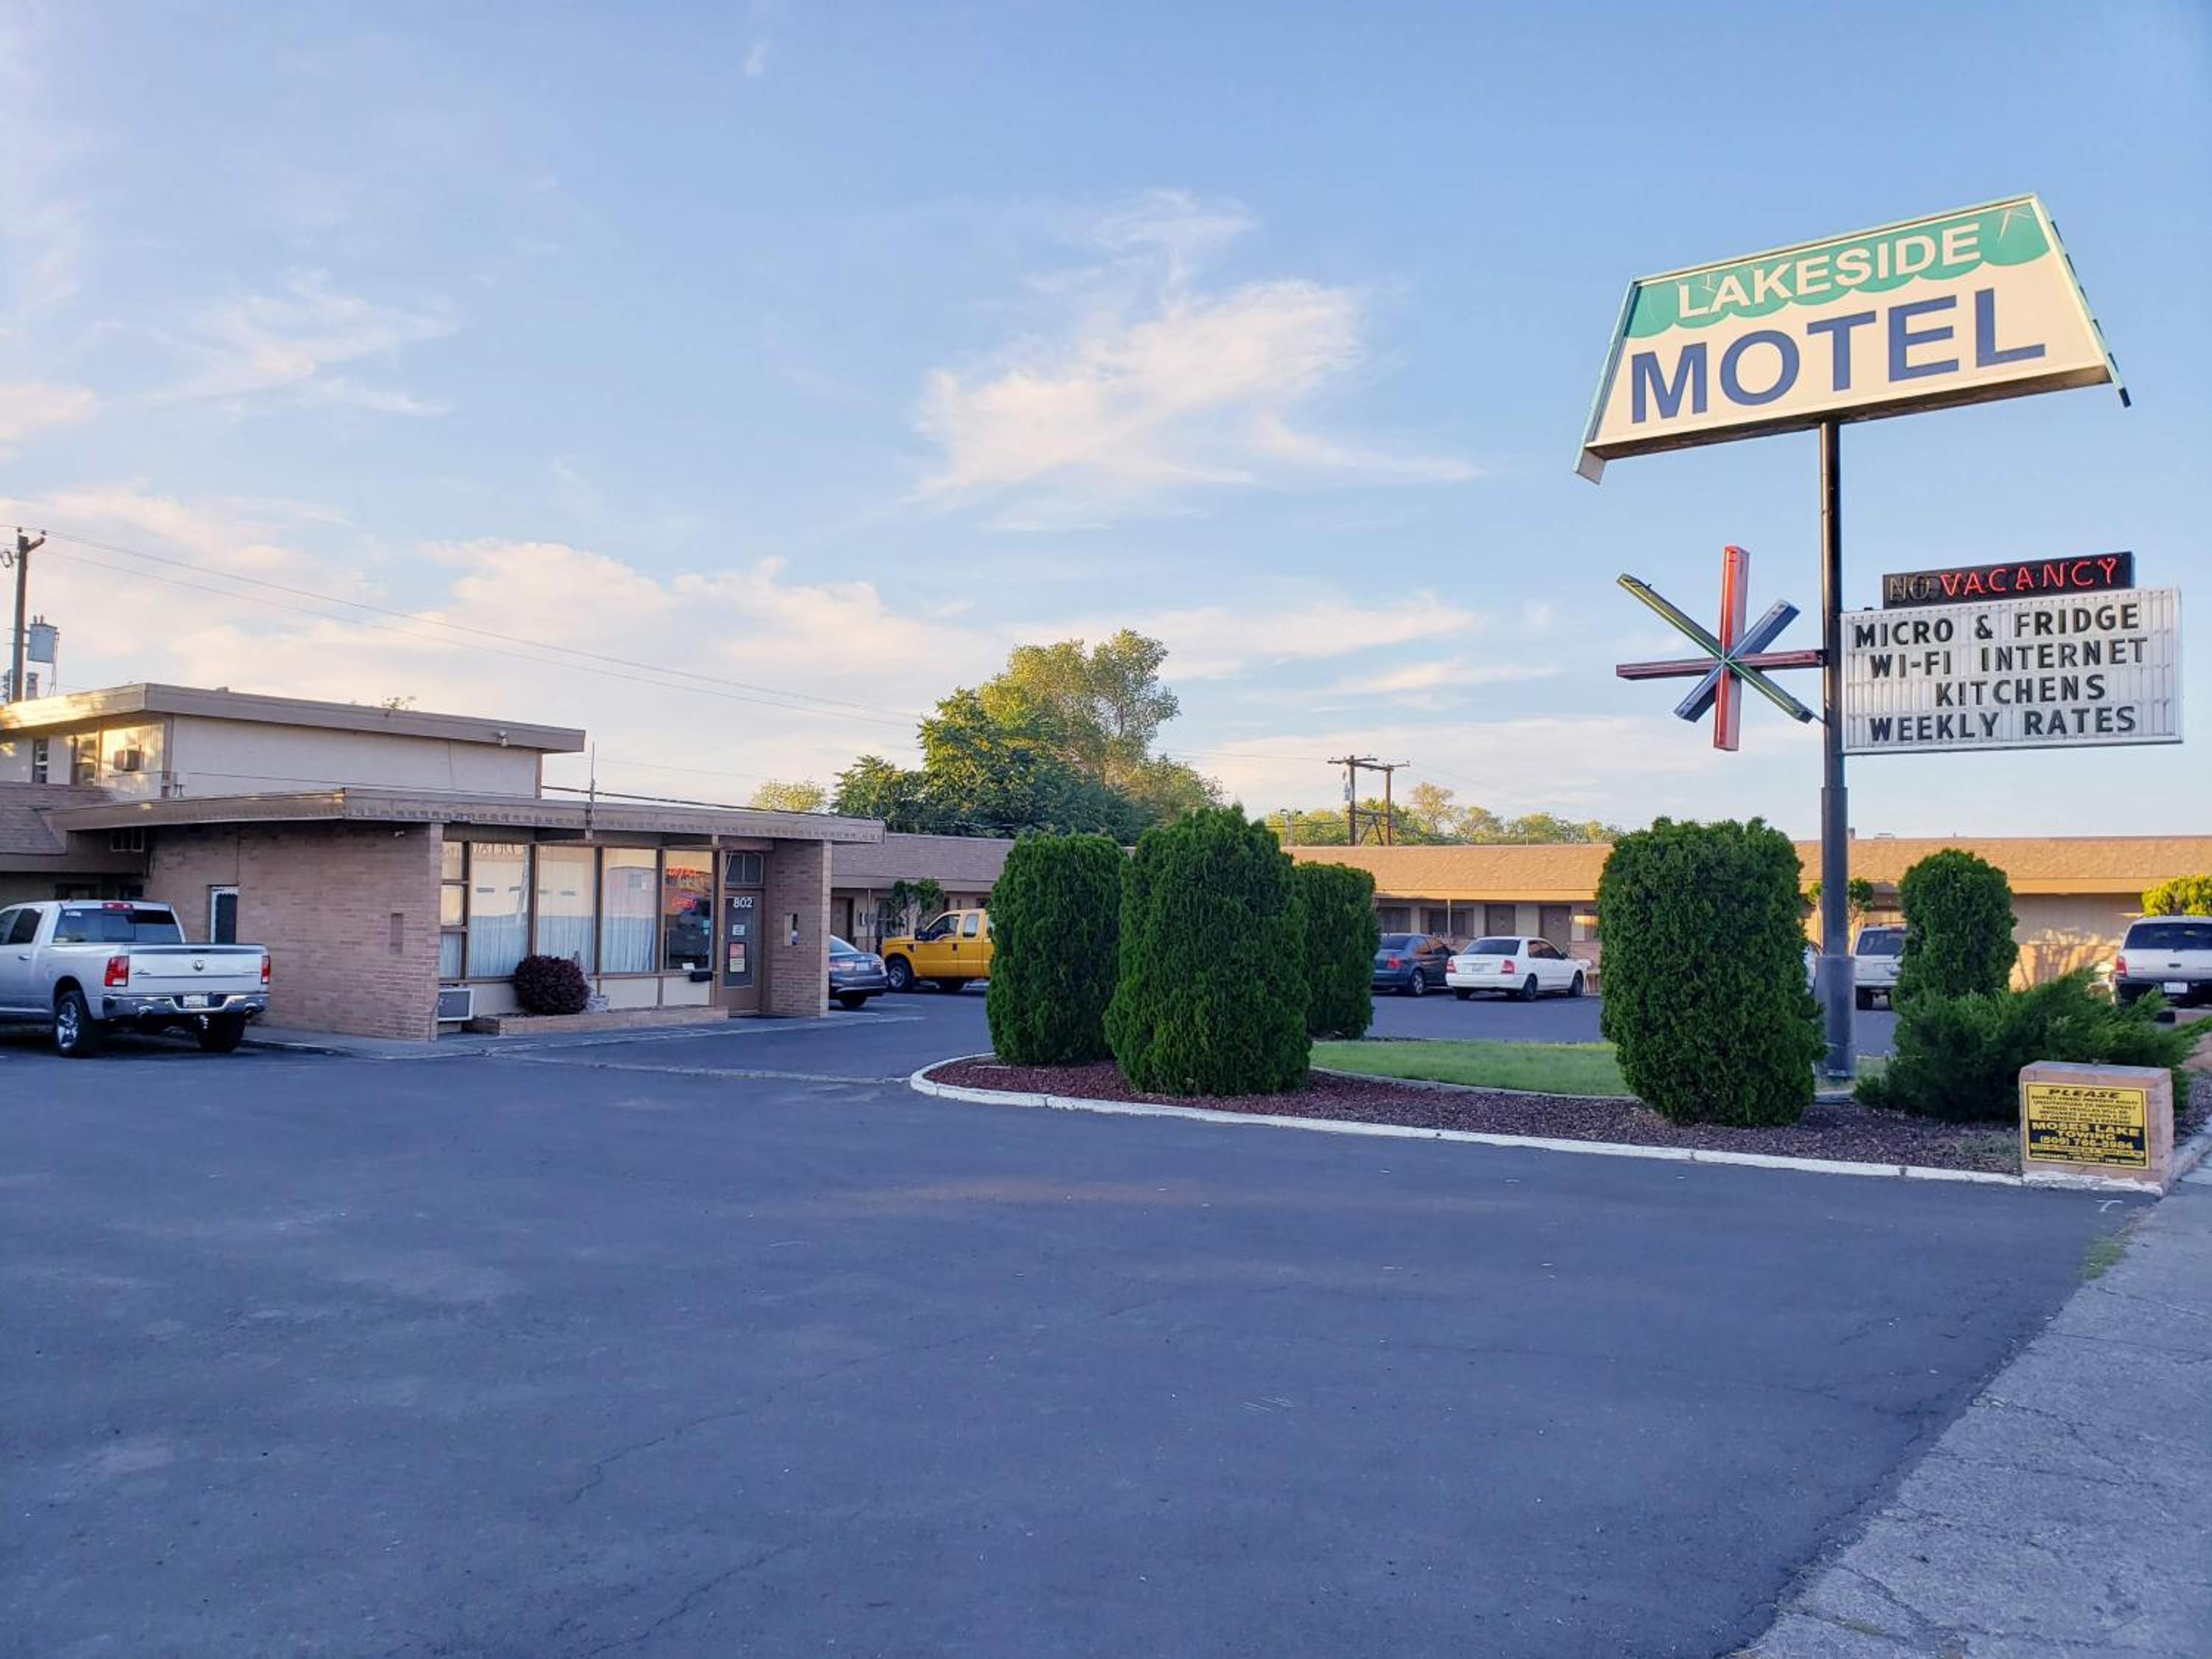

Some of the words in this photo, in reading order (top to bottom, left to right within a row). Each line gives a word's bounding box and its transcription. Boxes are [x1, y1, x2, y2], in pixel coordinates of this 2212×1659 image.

[1678, 223, 1981, 318] LAKESIDE
[1632, 288, 2046, 424] MOTEL
[1889, 574, 1930, 601] NO
[1940, 557, 2118, 597] VACANCY
[1855, 618, 1953, 648] MICRO
[1974, 614, 1993, 639] &
[2014, 603, 2139, 637] FRIDGE
[1870, 650, 1951, 678] WI-FI
[1981, 637, 2148, 672] INTERNET
[1935, 675, 2105, 707] KITCHENS
[1870, 712, 1999, 741] WEEKLY
[2024, 706, 2136, 736] RATES
[733, 897, 753, 908] 802
[2048, 1088, 2121, 1099] PLEASE
[2031, 1122, 2089, 1131] MOSES
[2096, 1124, 2140, 1137] LAKE
[2056, 1130, 2115, 1140] TOWING
